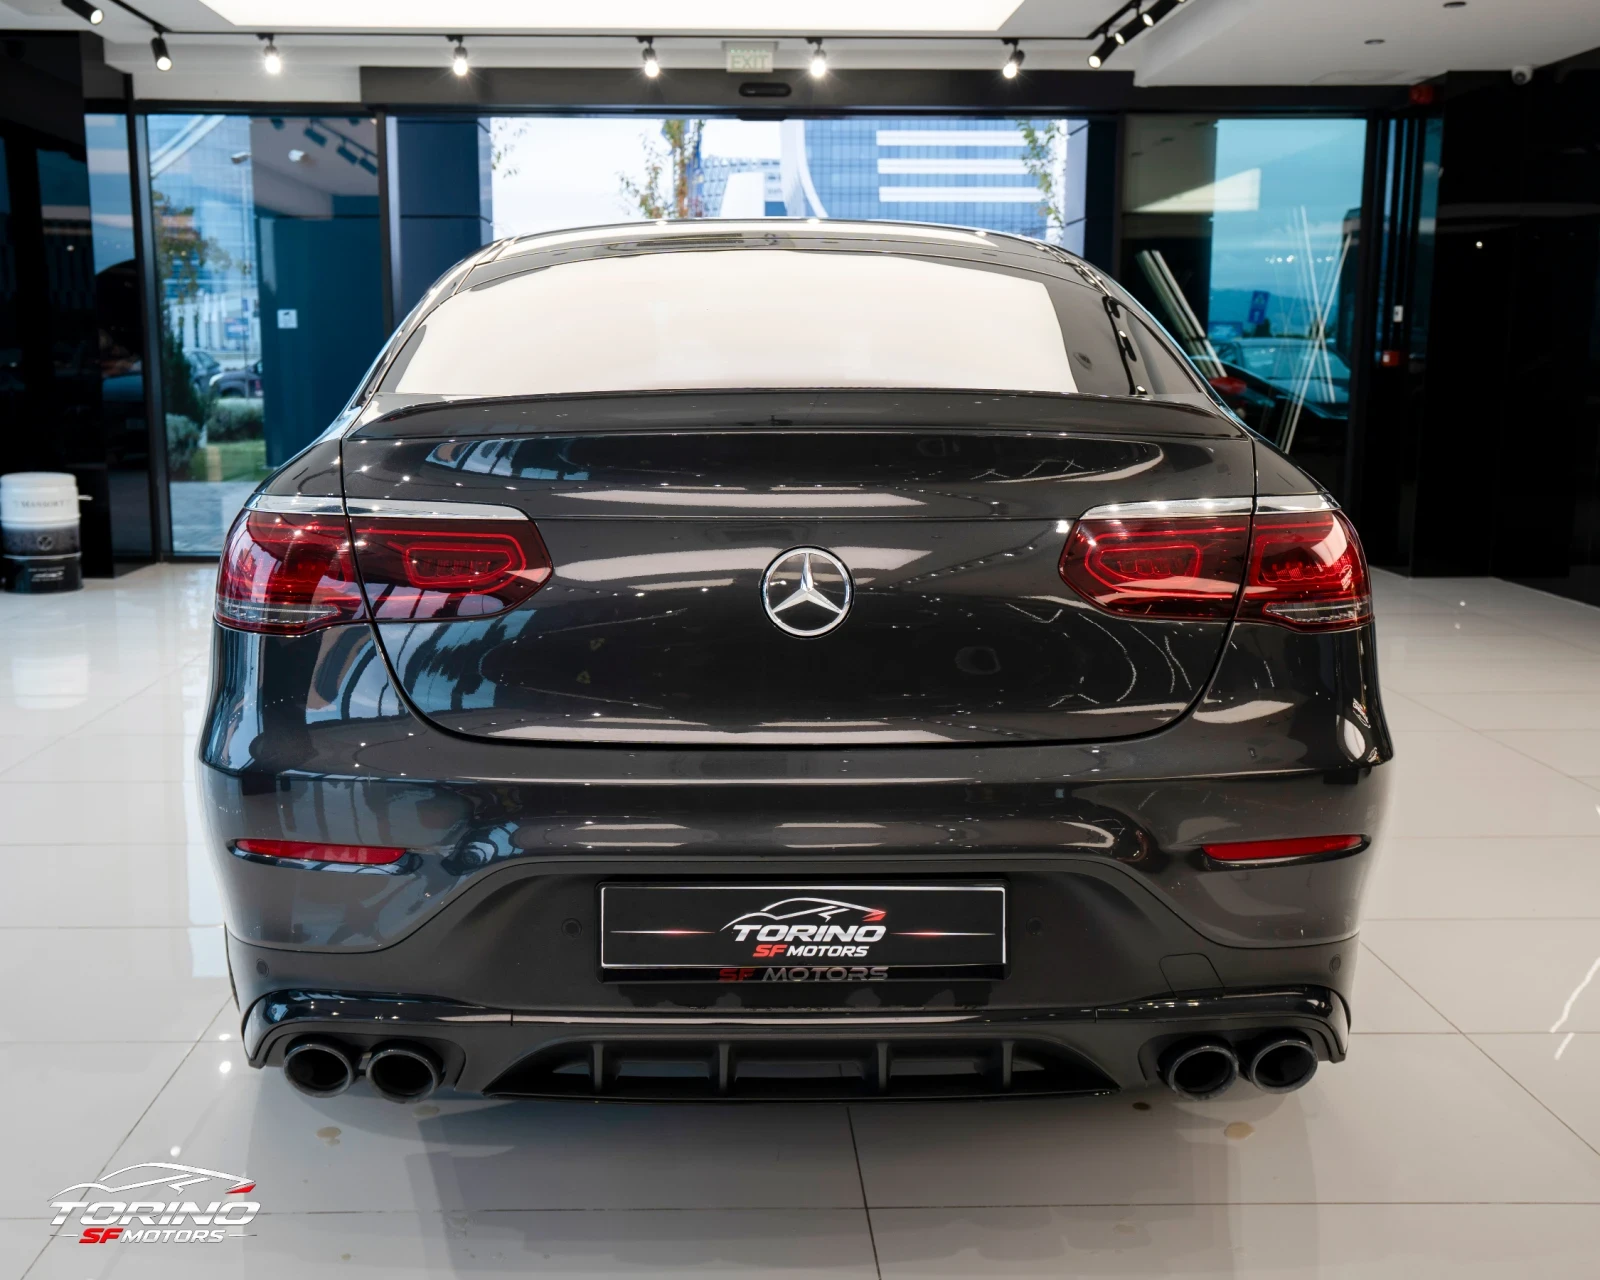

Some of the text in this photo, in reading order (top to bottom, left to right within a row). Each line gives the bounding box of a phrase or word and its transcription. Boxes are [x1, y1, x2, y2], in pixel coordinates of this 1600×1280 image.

[731, 55, 769, 71] EXIT
[733, 924, 887, 942] TORINO
[752, 944, 870, 957] SF MOTORS
[717, 966, 889, 982] SF MOTORS
